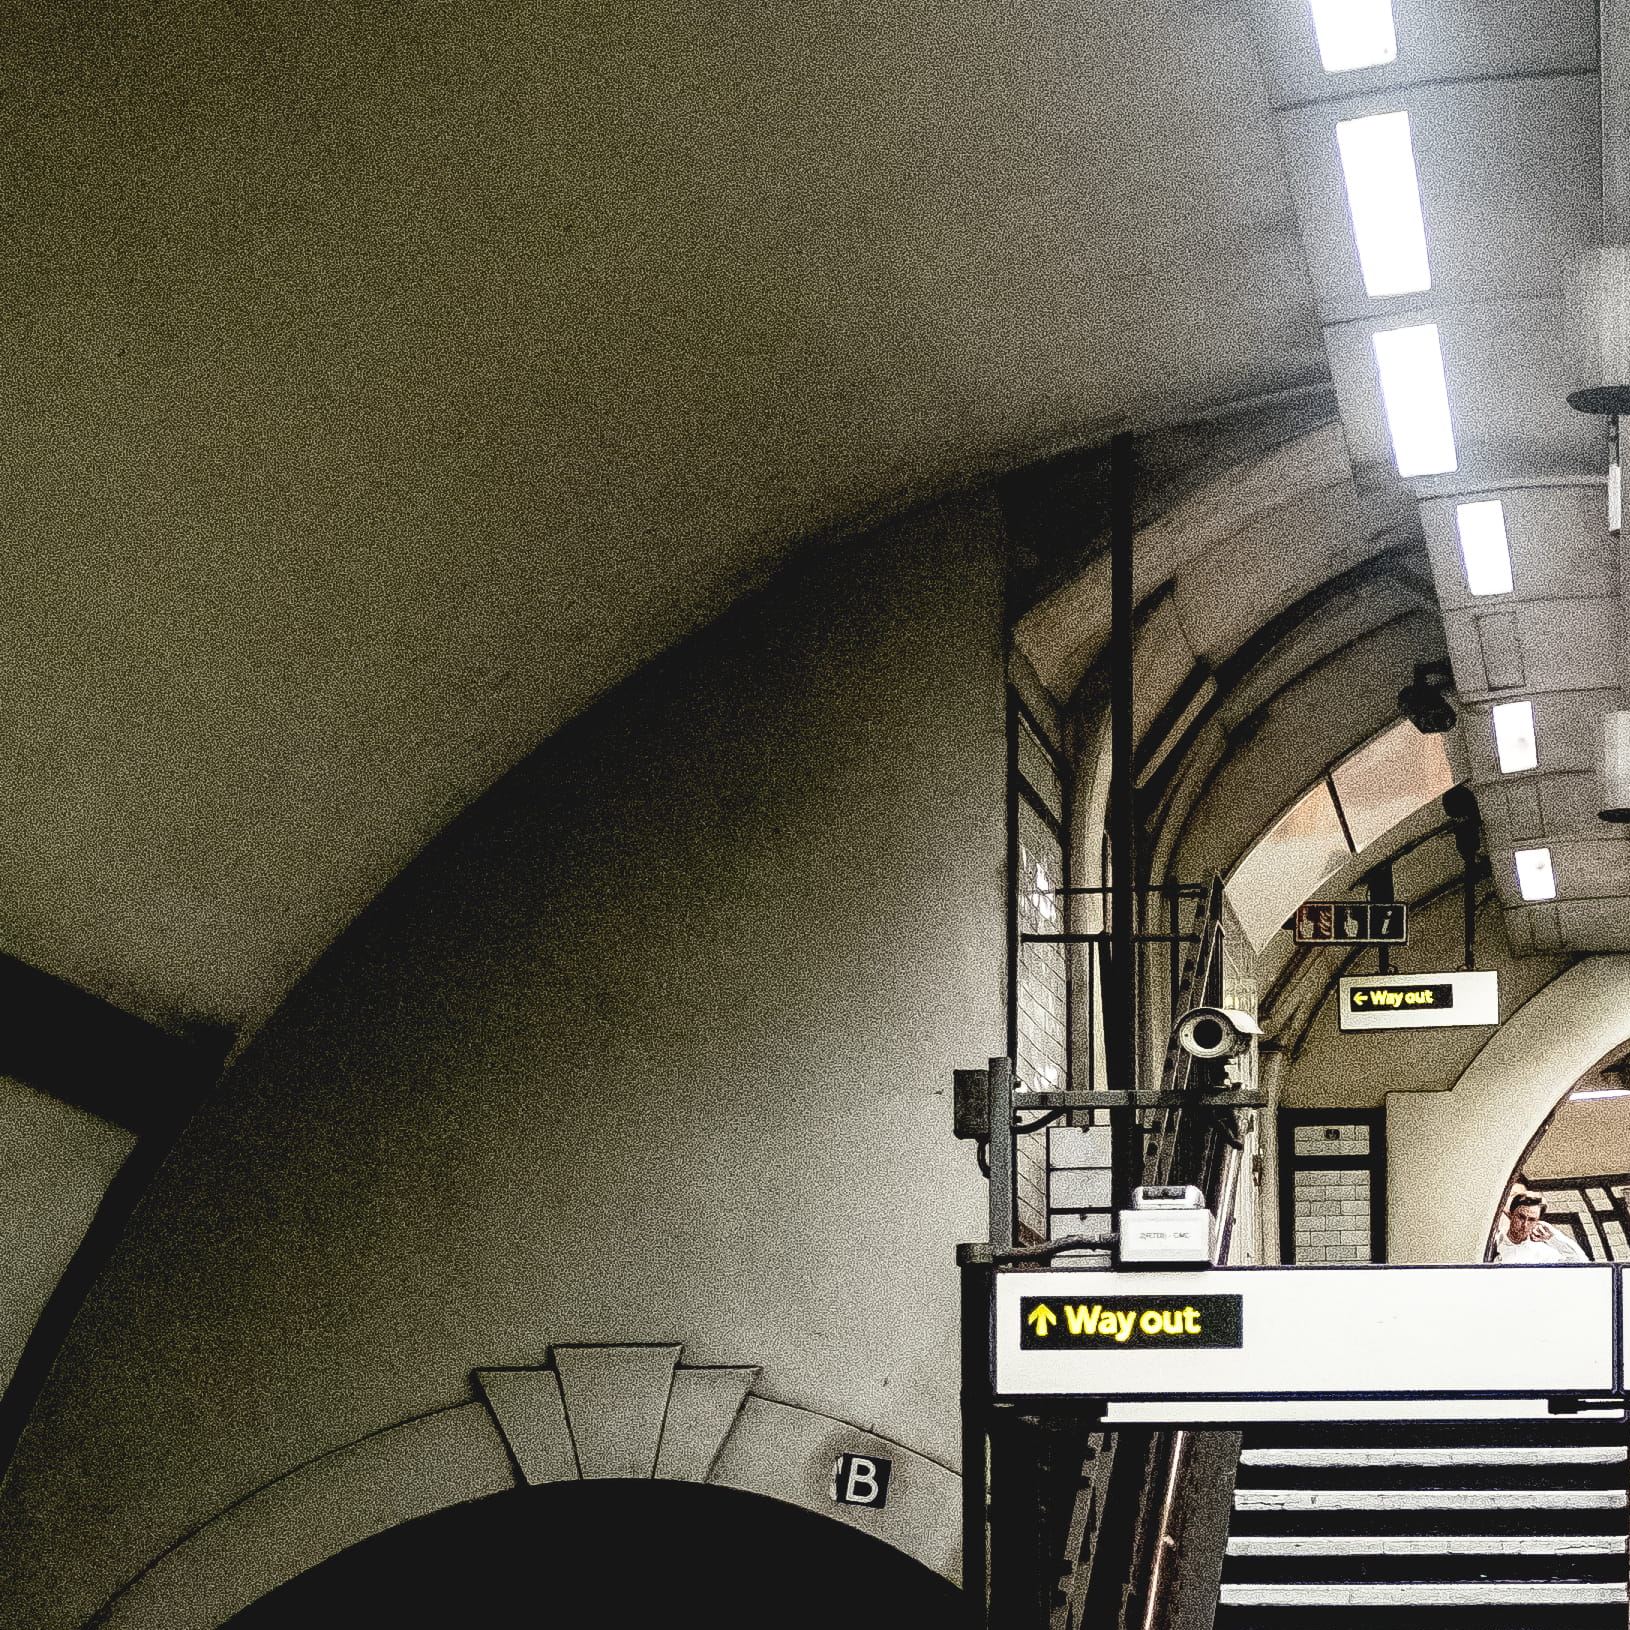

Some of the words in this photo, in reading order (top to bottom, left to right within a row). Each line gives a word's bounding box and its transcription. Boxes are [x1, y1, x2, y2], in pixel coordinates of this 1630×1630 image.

[1370, 990, 1404, 1007] Way
[1404, 989, 1434, 1004] out
[1063, 1304, 1137, 1342] Way
[1139, 1306, 1201, 1335] out
[845, 1457, 879, 1504] B
